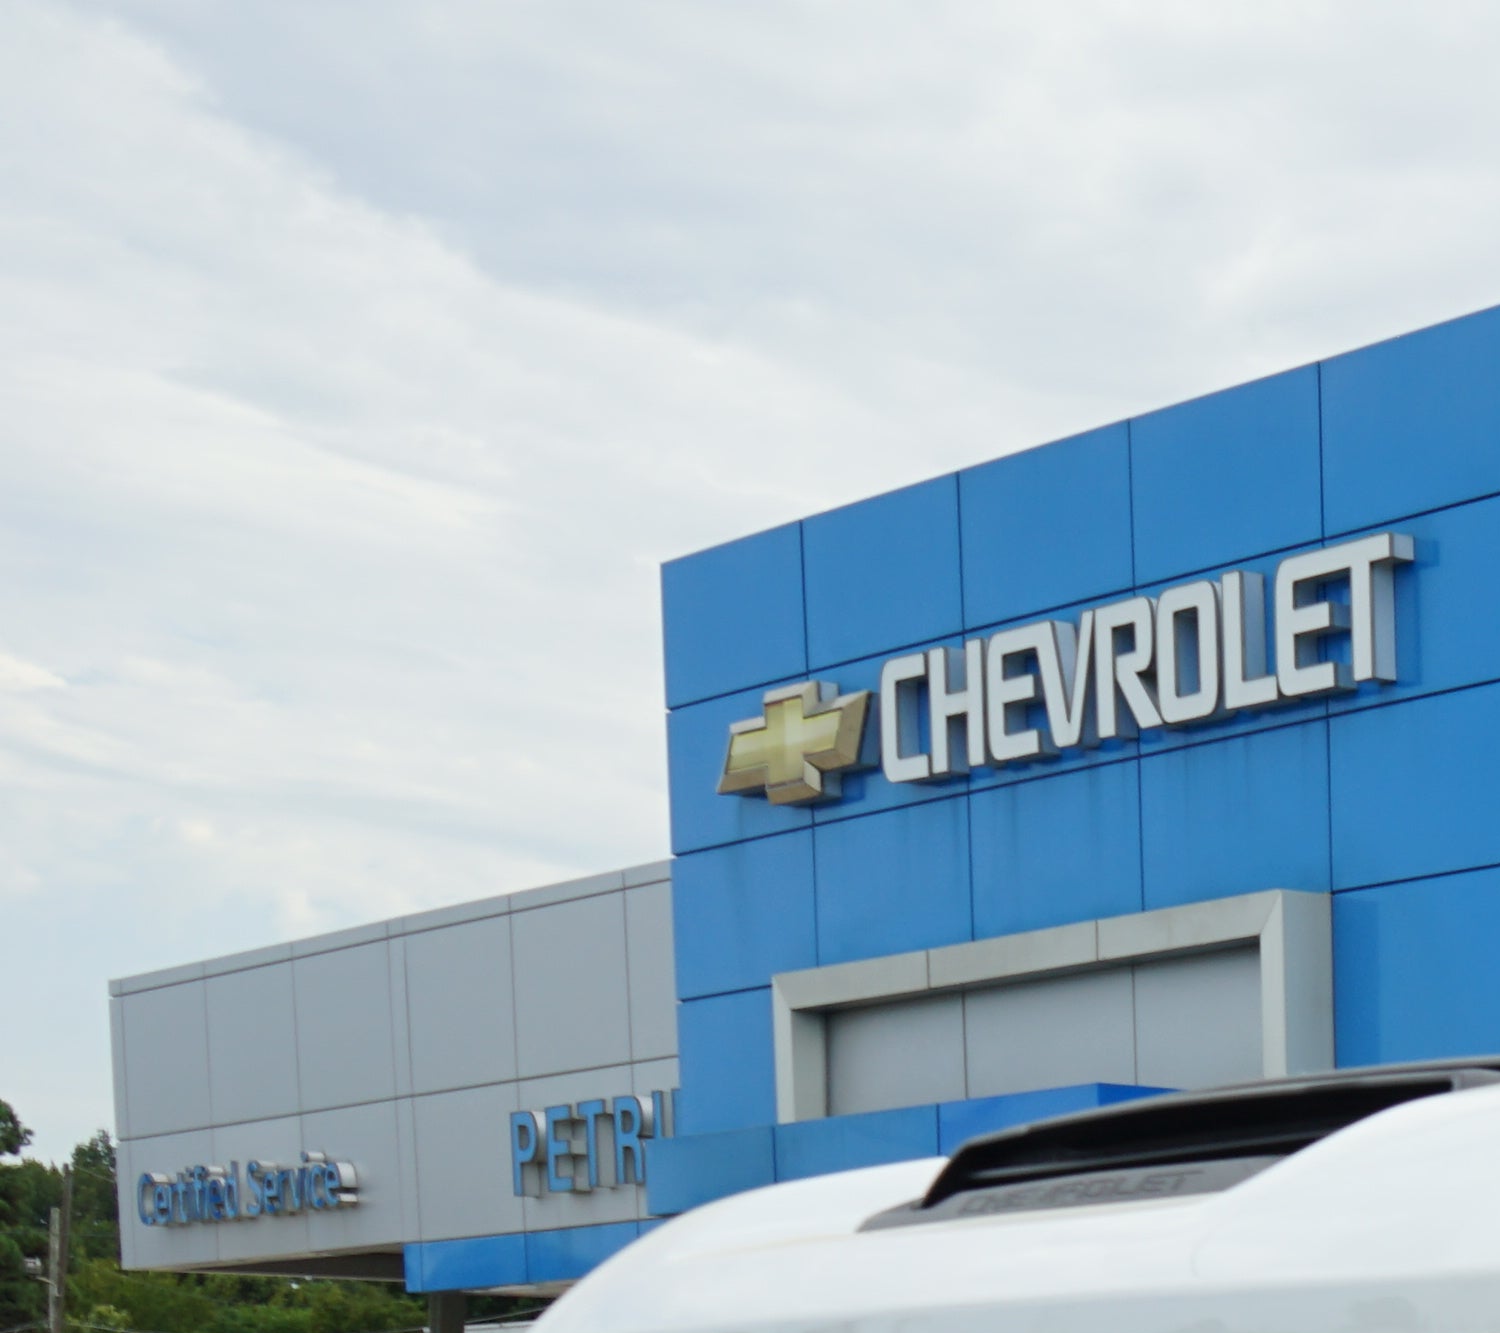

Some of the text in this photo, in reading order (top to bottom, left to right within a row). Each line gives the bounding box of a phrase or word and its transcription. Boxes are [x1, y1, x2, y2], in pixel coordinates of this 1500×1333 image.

[880, 532, 1414, 784] CHEVROLET
[137, 1151, 358, 1226] Certified Service
